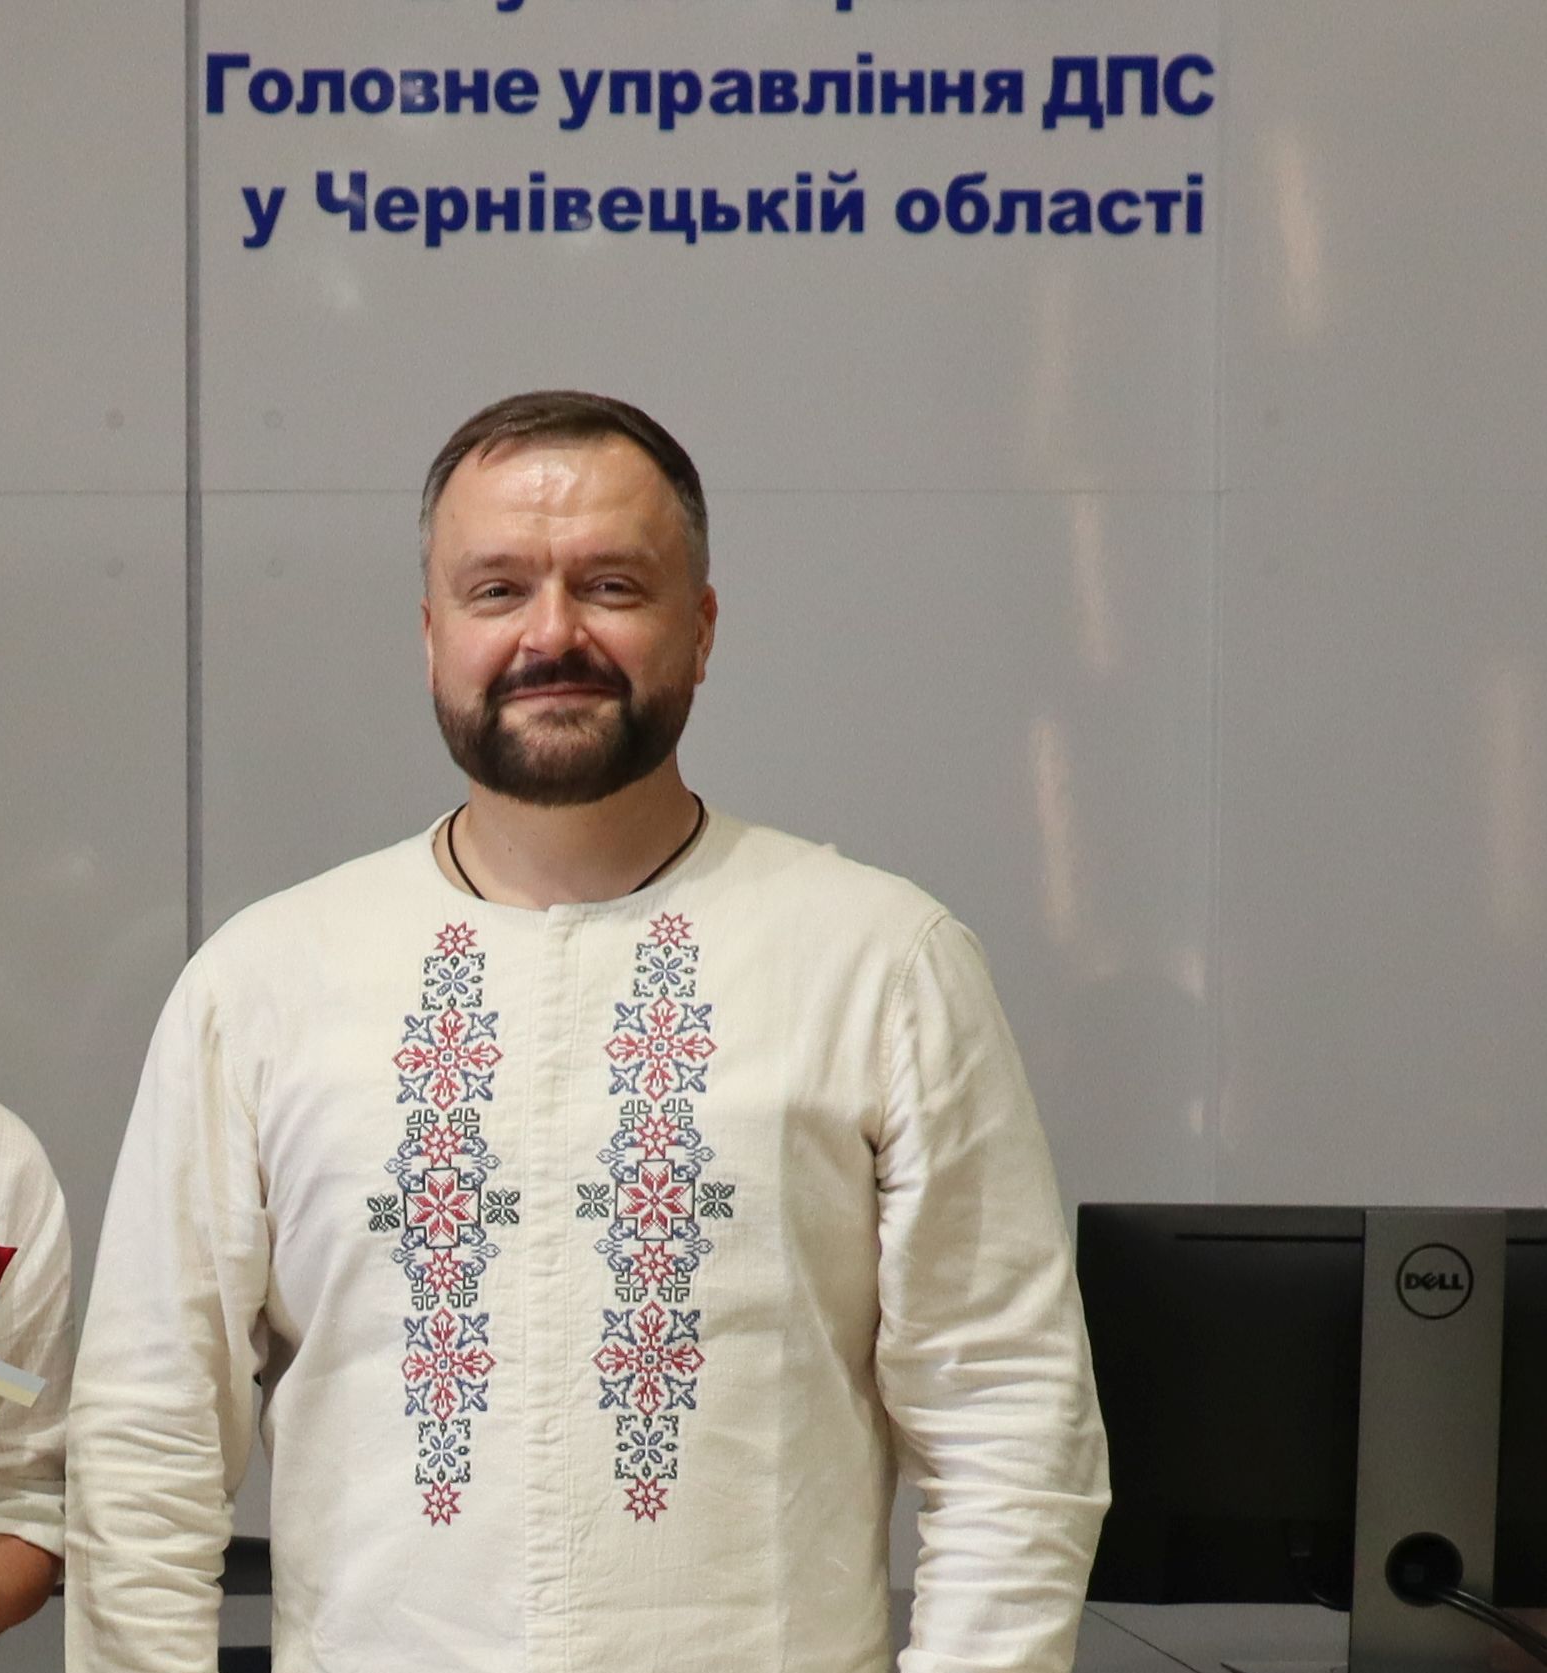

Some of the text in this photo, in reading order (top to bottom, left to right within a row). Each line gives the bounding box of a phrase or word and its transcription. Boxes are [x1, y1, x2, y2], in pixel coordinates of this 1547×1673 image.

[206, 53, 1215, 132] Головне управління ДПС
[243, 170, 1204, 249] у Чернівецькій області
[1404, 1272, 1464, 1291] DELL
